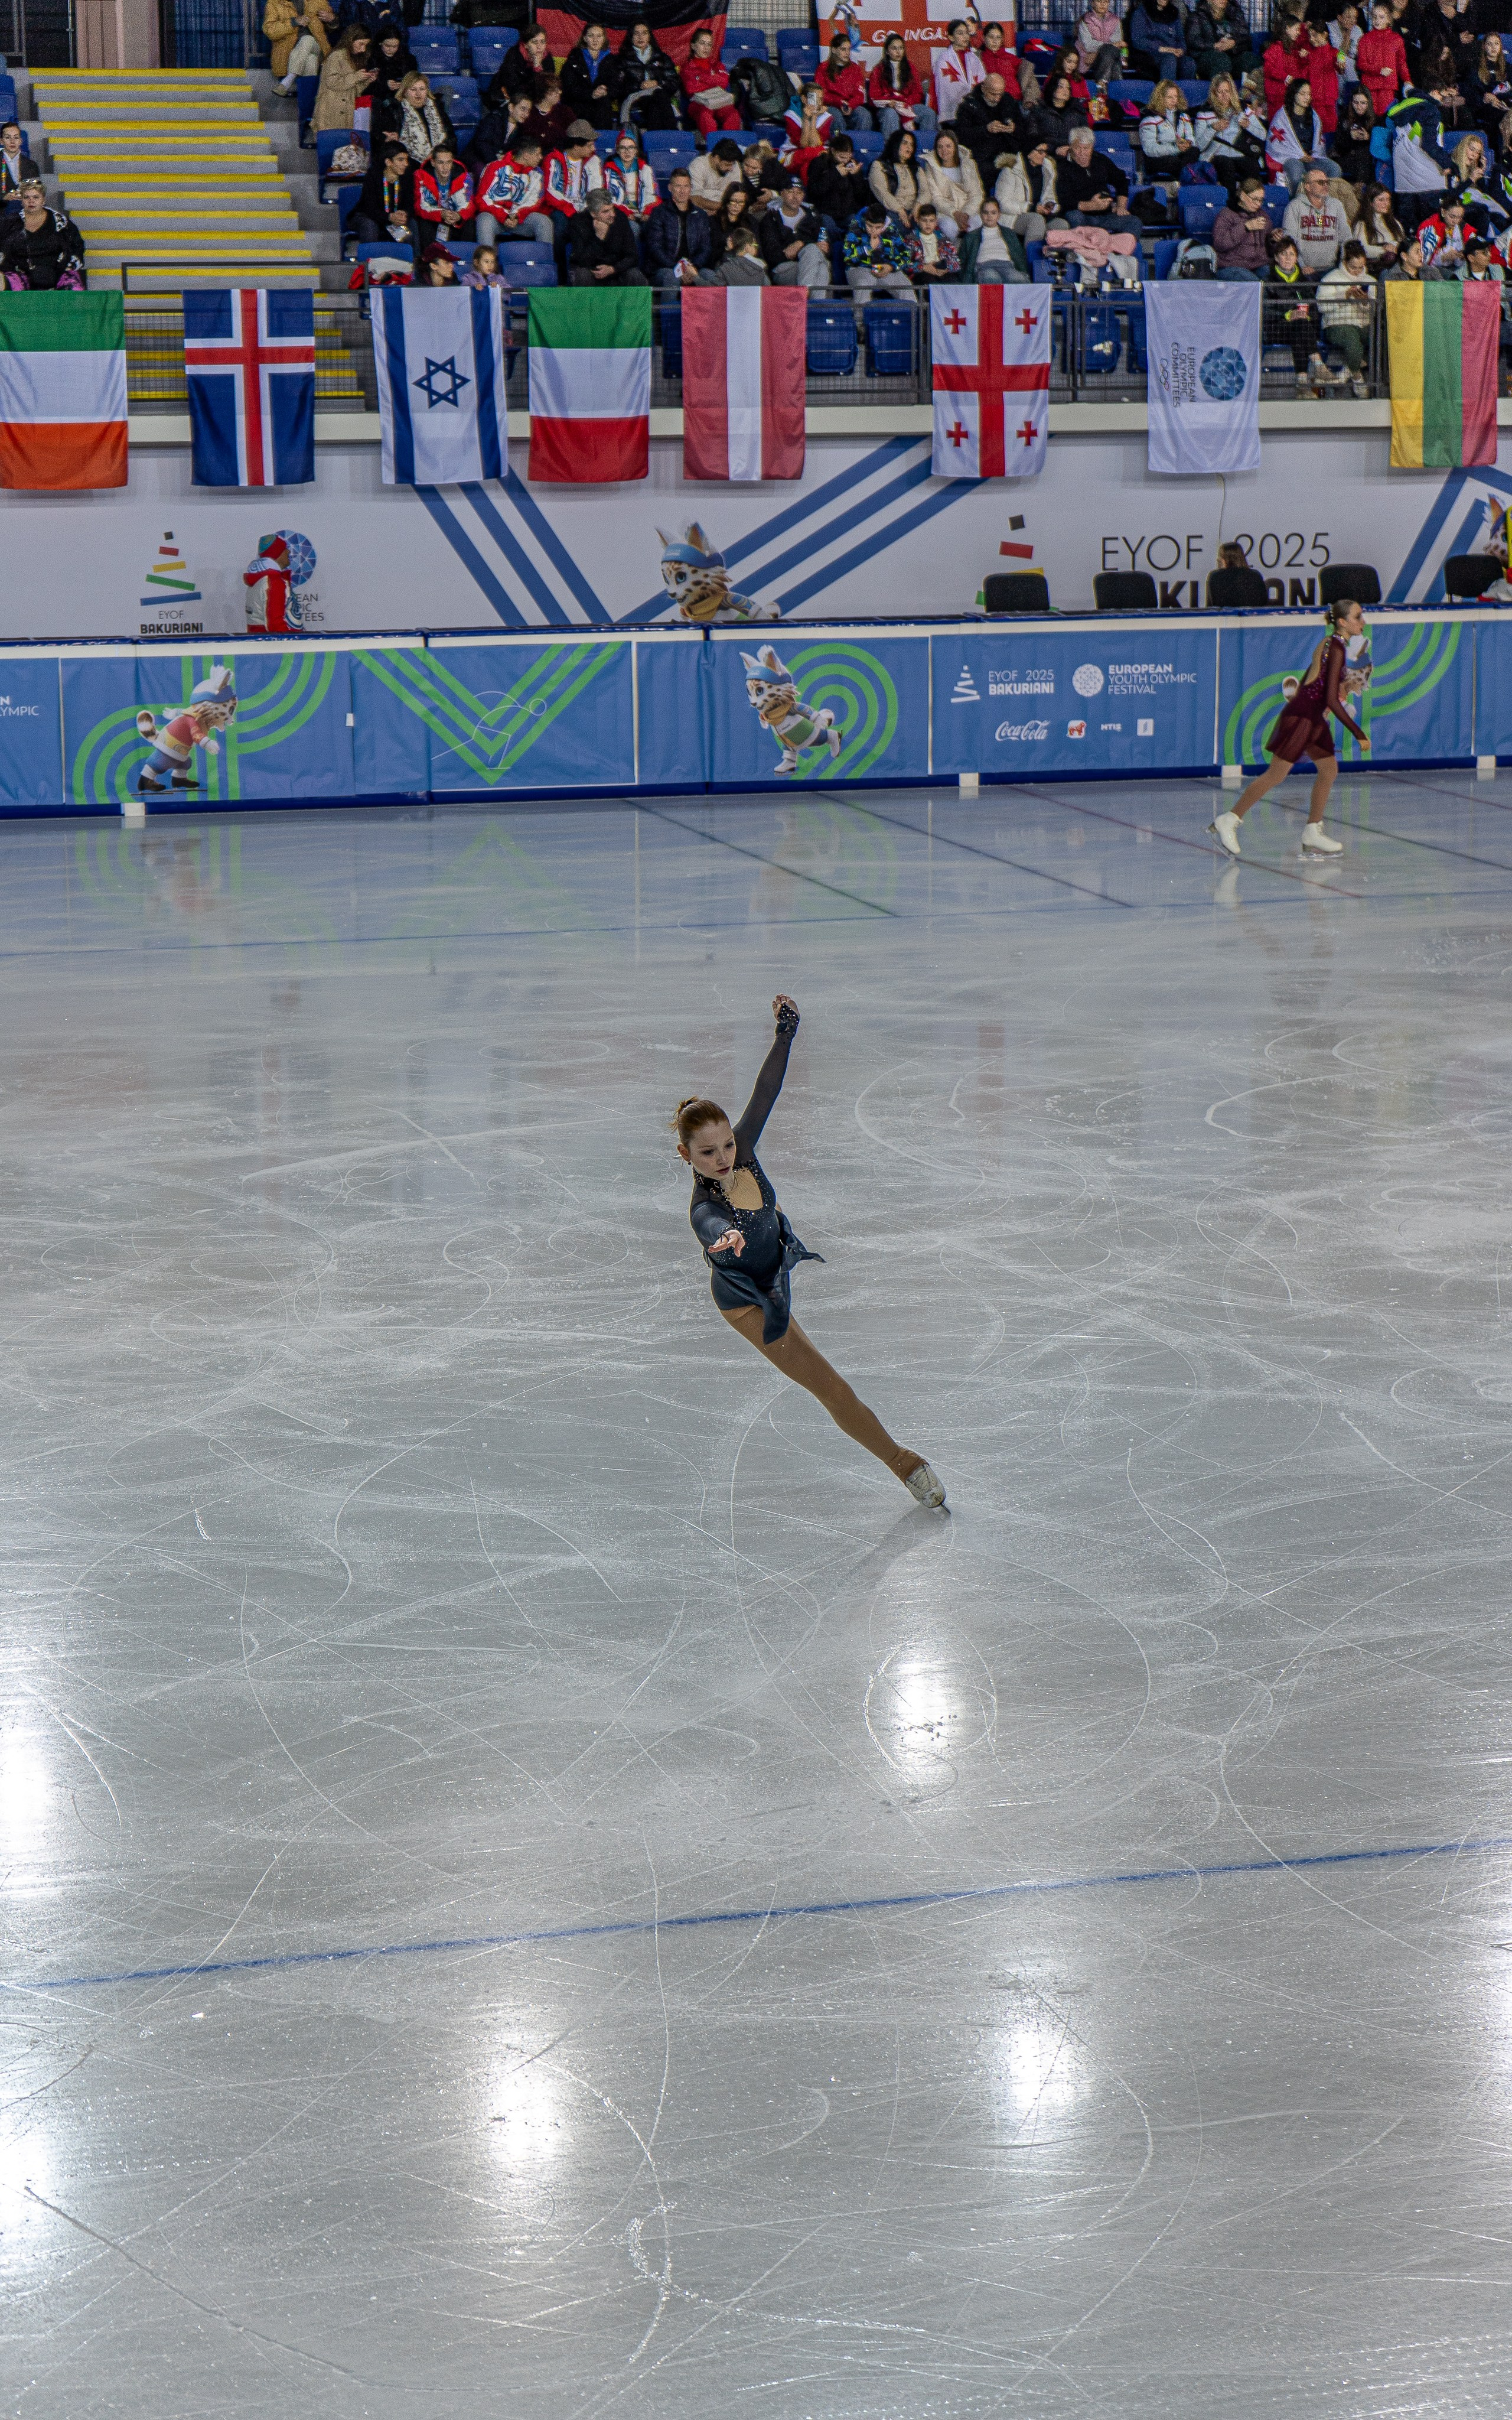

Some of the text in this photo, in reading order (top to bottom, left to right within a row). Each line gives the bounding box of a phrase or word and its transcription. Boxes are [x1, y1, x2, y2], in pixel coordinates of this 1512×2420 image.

[1171, 342, 1180, 408] COMMITTEES
[1179, 353, 1188, 398] OLYMPIC
[1187, 347, 1195, 402] EUROPEAN
[1102, 534, 1203, 571] EYOF
[158, 610, 184, 620] EYOF
[140, 622, 203, 634] BAKURIANI
[988, 668, 1055, 682] EYOF 2025
[1108, 663, 1173, 674] EUROPEAN
[1108, 672, 1197, 684] YOUTH OLYMPIC
[988, 681, 1055, 695] BAKURIANI
[1108, 684, 1156, 695] FESTIVAL
[0, 705, 39, 717] YMPIC
